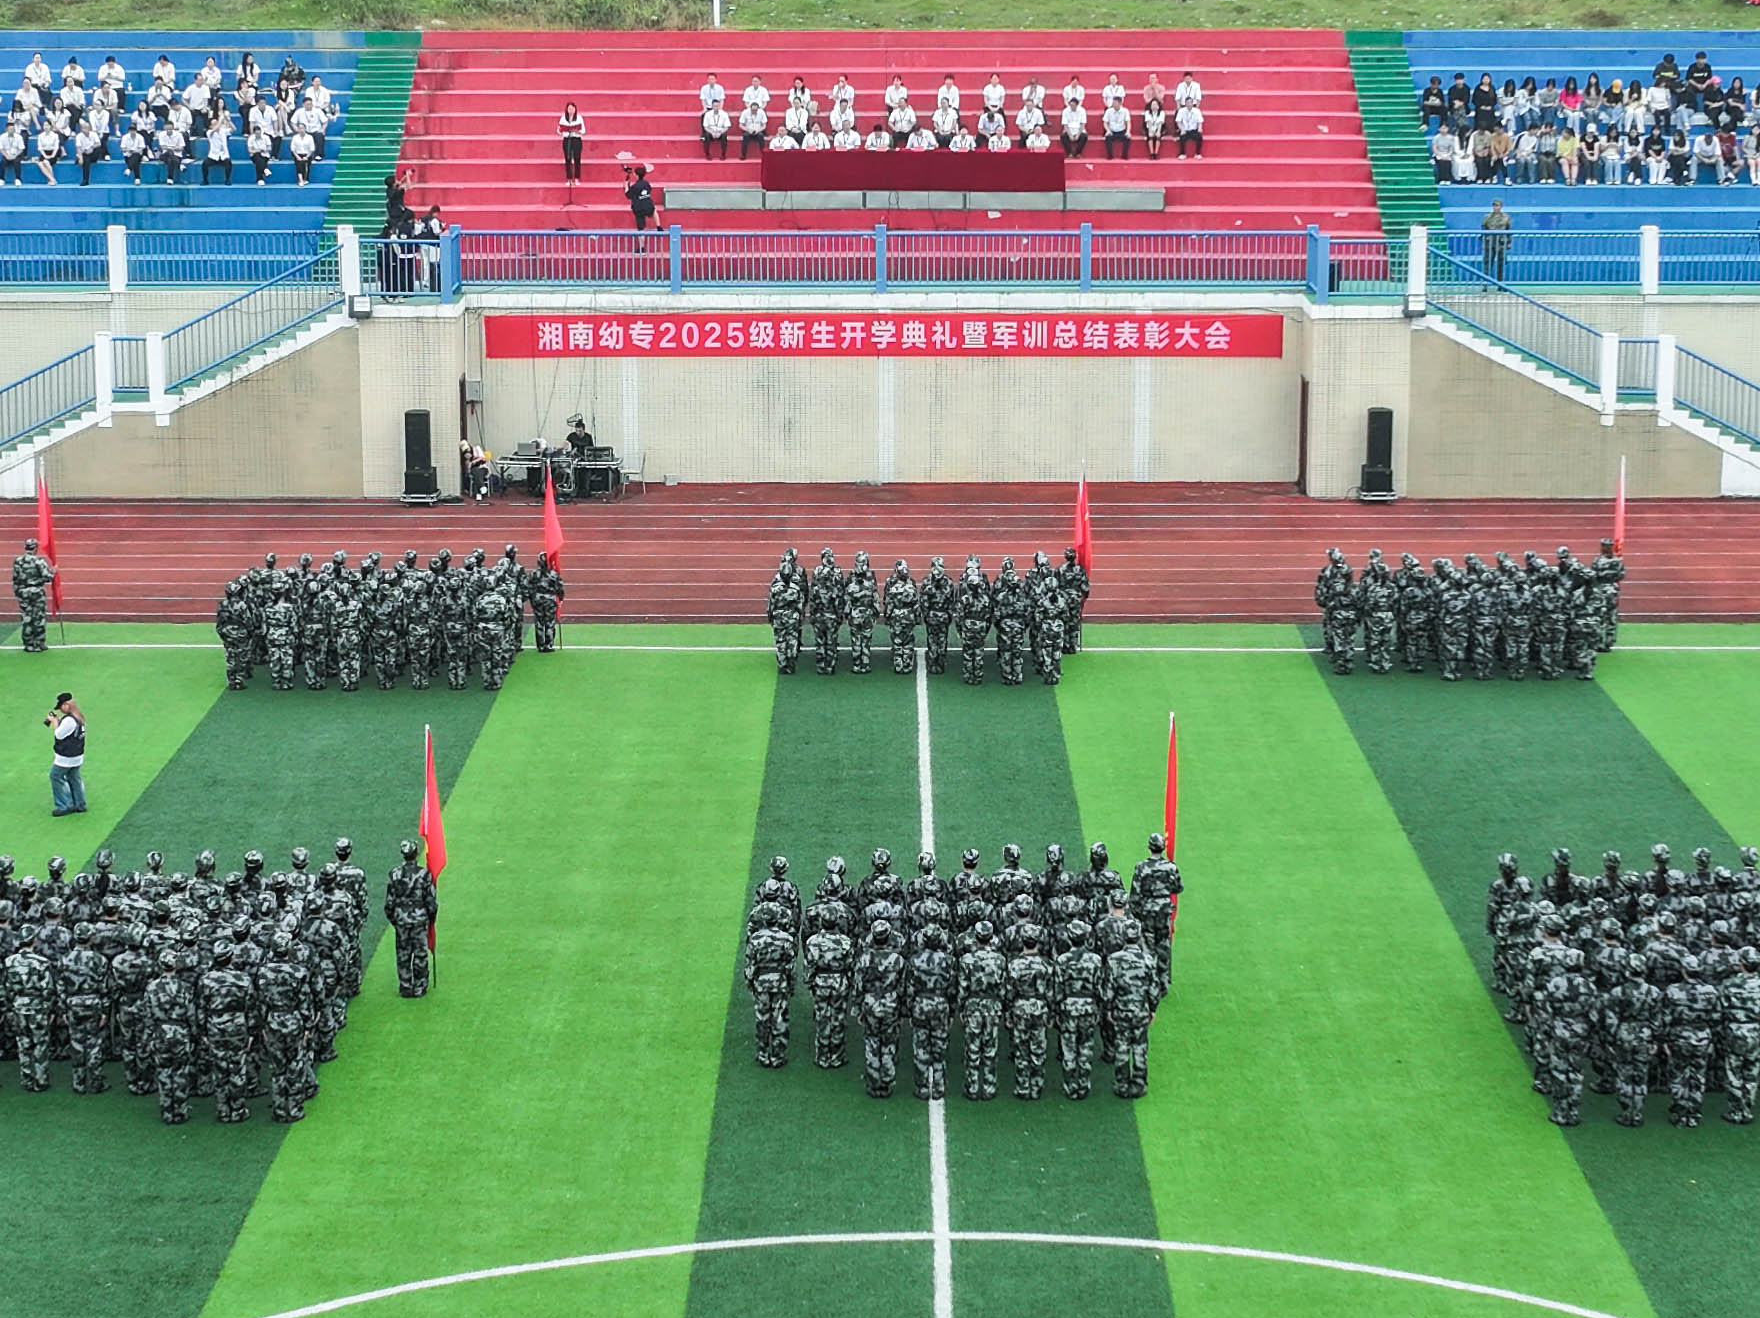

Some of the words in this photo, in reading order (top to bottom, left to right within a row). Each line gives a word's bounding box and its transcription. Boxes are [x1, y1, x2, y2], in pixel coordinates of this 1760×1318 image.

[537, 320, 1232, 350] 湘南幼专2025级新生开学典礼暨军训总结表彰大会
